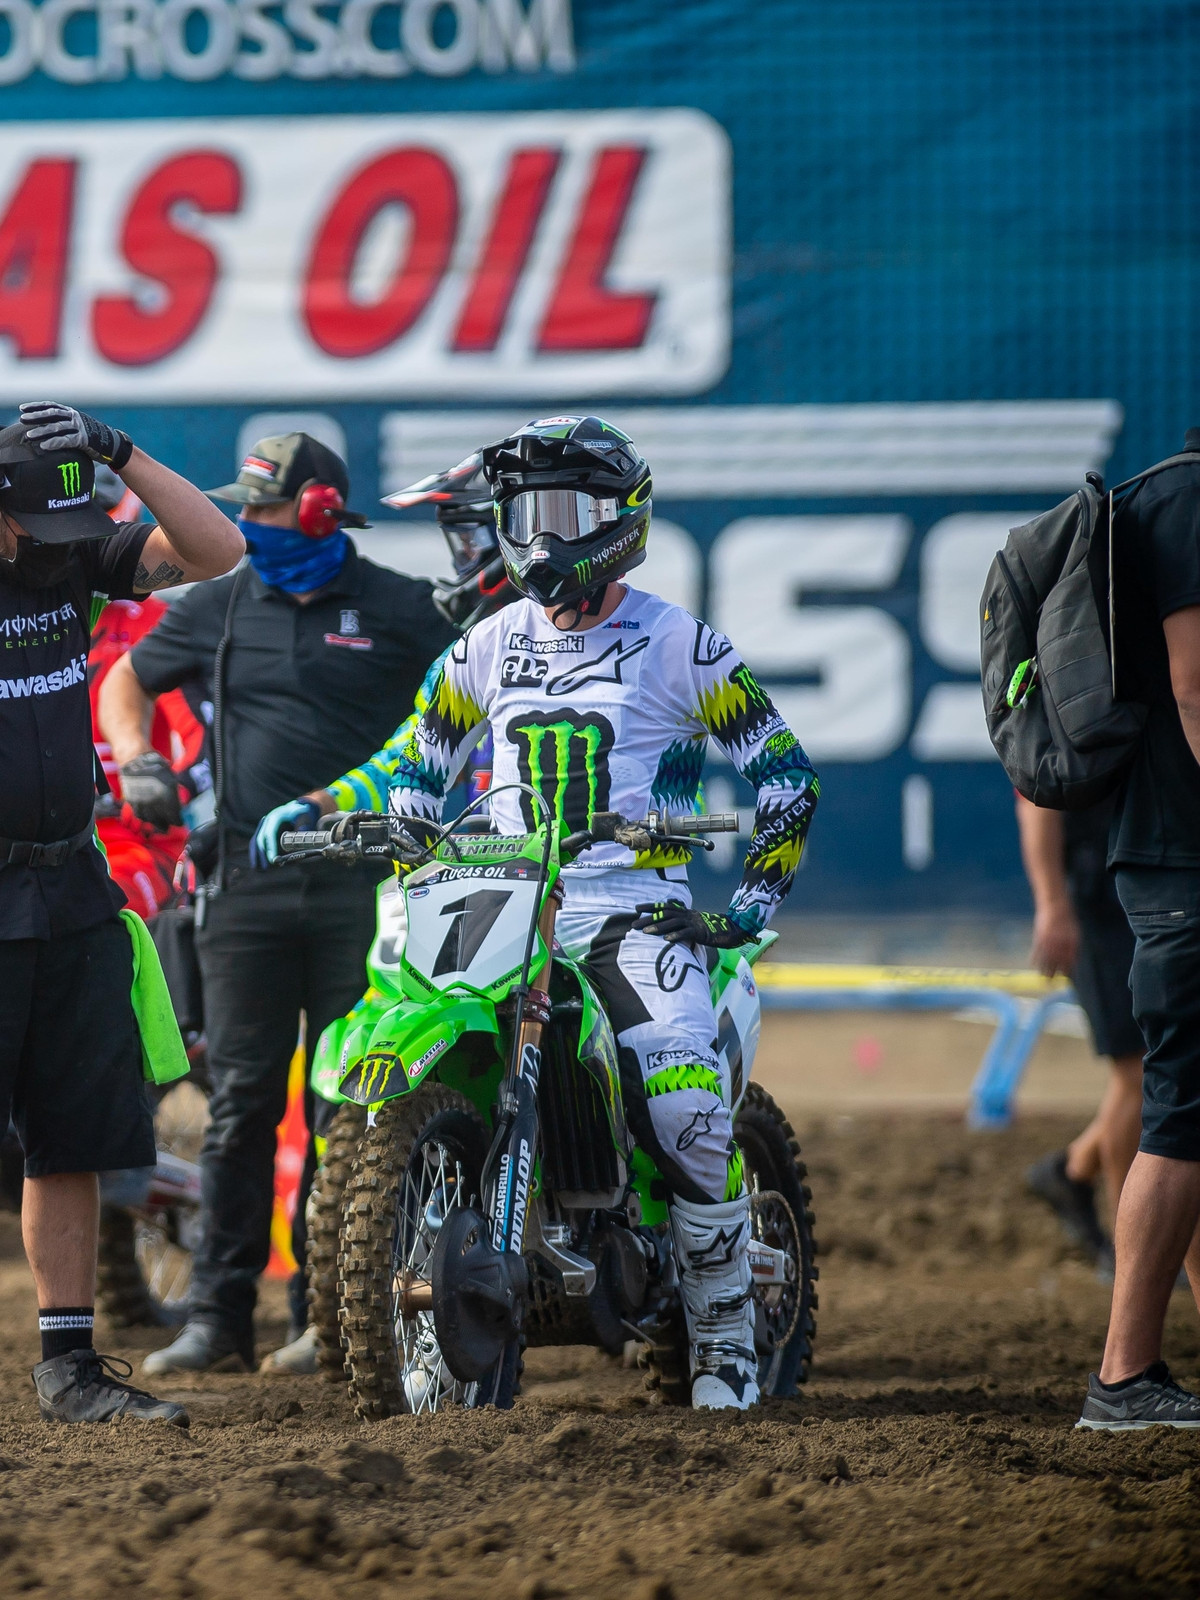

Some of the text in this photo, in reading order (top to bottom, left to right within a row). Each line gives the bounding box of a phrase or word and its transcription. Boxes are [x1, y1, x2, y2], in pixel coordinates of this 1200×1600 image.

[300, 143, 660, 358] OIL
[48, 491, 90, 509] Kawasaki
[591, 528, 640, 566] MONSTER
[5, 627, 69, 649] ENERGY
[510, 634, 582, 652] Kawasaki
[748, 797, 811, 857] MONSTER
[761, 816, 808, 856] ENERGY
[441, 867, 483, 882] LUCAS
[484, 866, 507, 878] OIL
[431, 889, 515, 979] 1
[407, 966, 435, 994] Kawasaki
[419, 1039, 446, 1067] MAXIMA
[495, 1153, 511, 1221] CARRILLO
[509, 1138, 532, 1256] DUNLOP
[40, 1318, 94, 1328] Kawasaki
